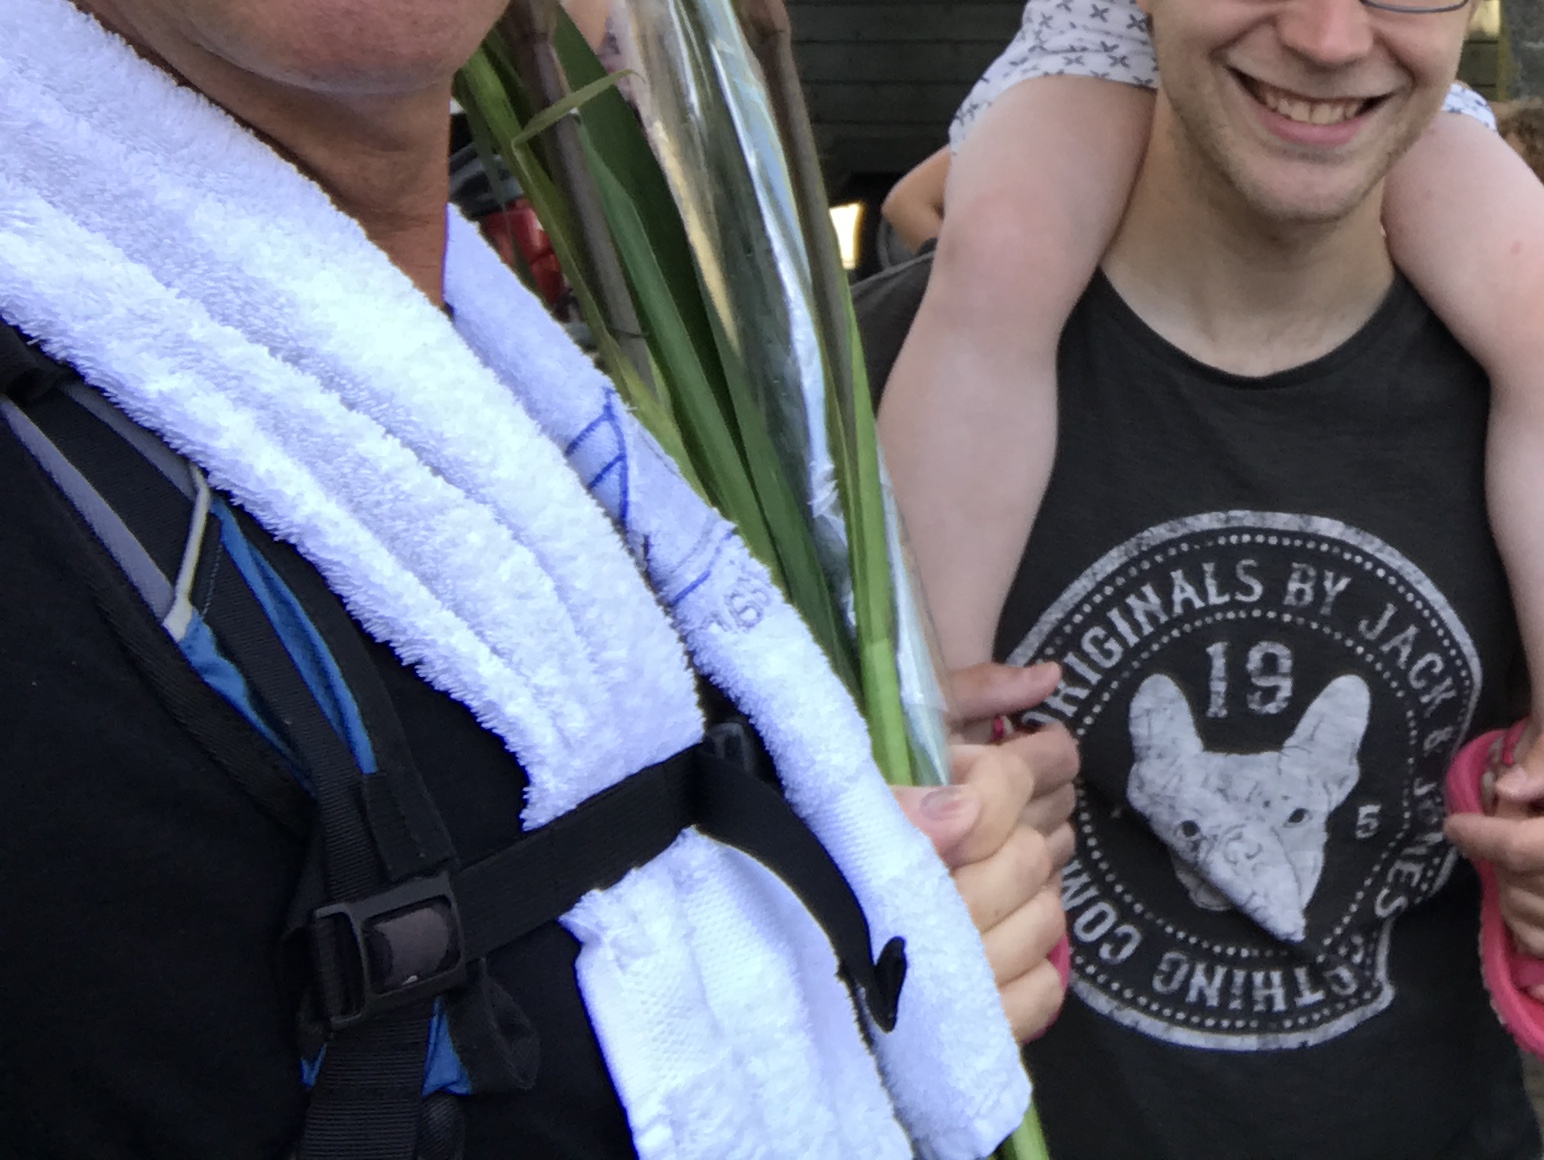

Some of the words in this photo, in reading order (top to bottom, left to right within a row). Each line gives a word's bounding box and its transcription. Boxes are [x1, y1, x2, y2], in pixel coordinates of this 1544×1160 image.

[1206, 640, 1294, 718] 19
[1284, 562, 1351, 616] BY
[1359, 603, 1458, 719] JACK
